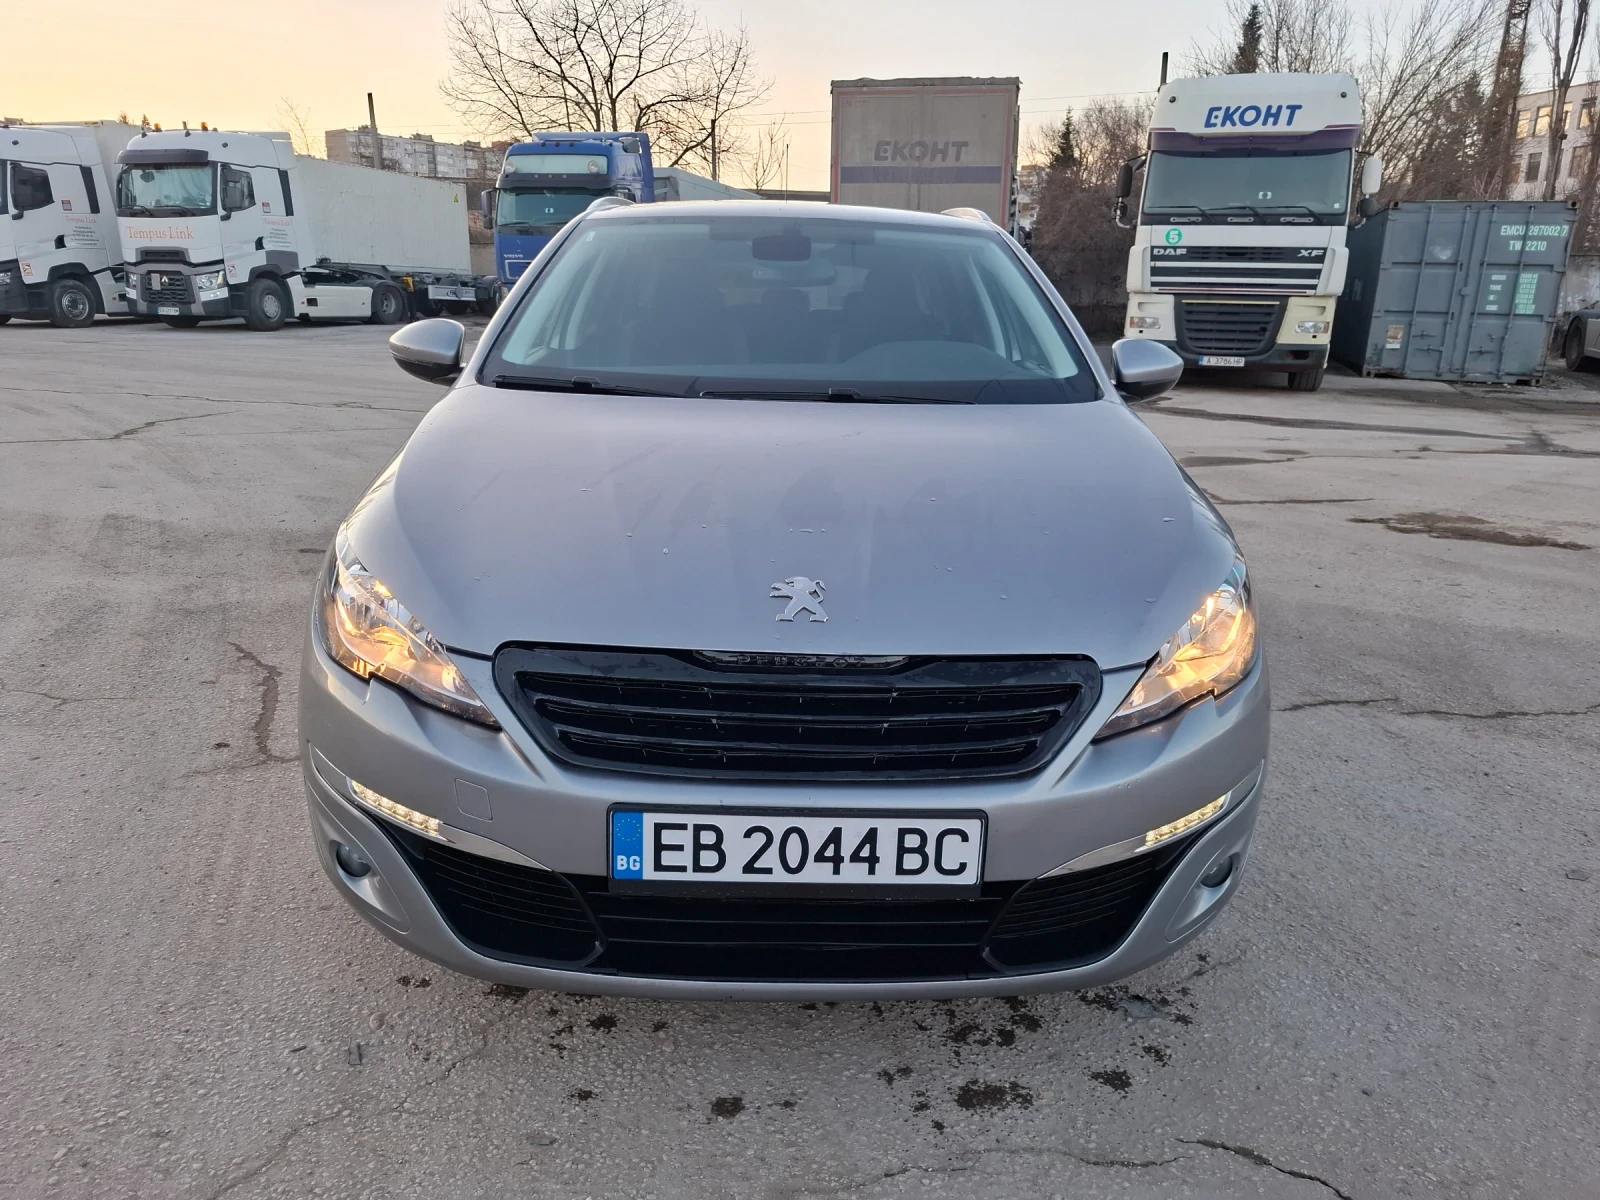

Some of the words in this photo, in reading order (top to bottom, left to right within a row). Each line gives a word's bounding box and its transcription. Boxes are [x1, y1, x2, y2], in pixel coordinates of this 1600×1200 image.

[1204, 104, 1303, 128] ЕКОНТ
[874, 140, 969, 162] ЕКОНТ
[126, 226, 167, 242] Tempus
[168, 226, 194, 239] Link
[1501, 225, 1526, 236] EMCU
[1168, 231, 1179, 243] 5
[1509, 241, 1523, 250] TW
[1525, 241, 1547, 250] 2210
[1153, 248, 1187, 256] DAF
[1297, 249, 1325, 257] XF
[1206, 357, 1212, 365] A
[1215, 357, 1232, 365] 3786
[653, 822, 727, 873] EB
[742, 825, 880, 876] 2044
[895, 827, 970, 876] BC
[616, 855, 641, 870] BG
